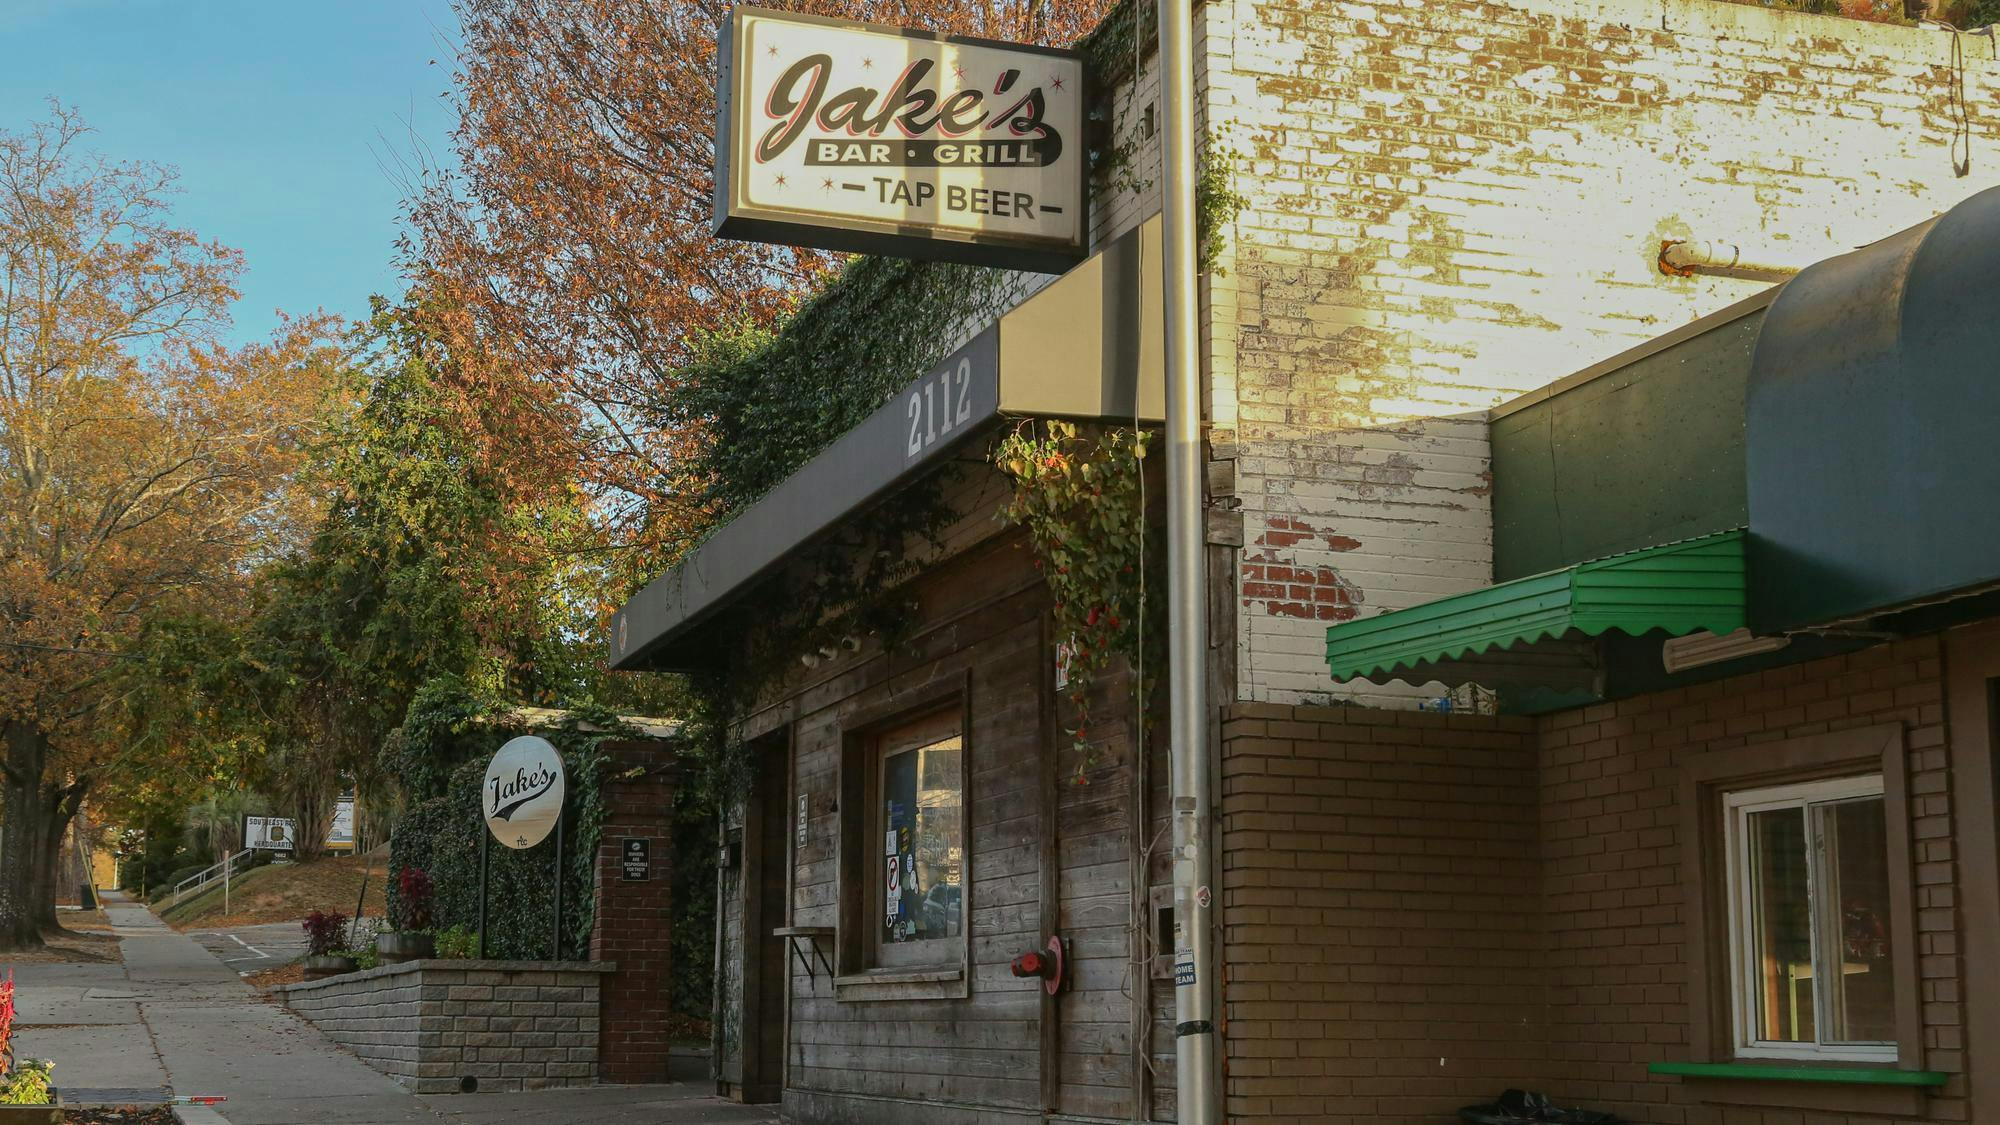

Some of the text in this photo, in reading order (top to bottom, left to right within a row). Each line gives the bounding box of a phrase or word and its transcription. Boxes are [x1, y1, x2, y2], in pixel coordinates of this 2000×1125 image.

[755, 53, 1048, 164] Jake's
[816, 143, 1036, 164] BAR GRILL
[872, 176, 1036, 220] TAP BEER
[907, 356, 971, 458] 2112
[489, 762, 549, 814] Jake's
[249, 818, 283, 826] SOUEAST
